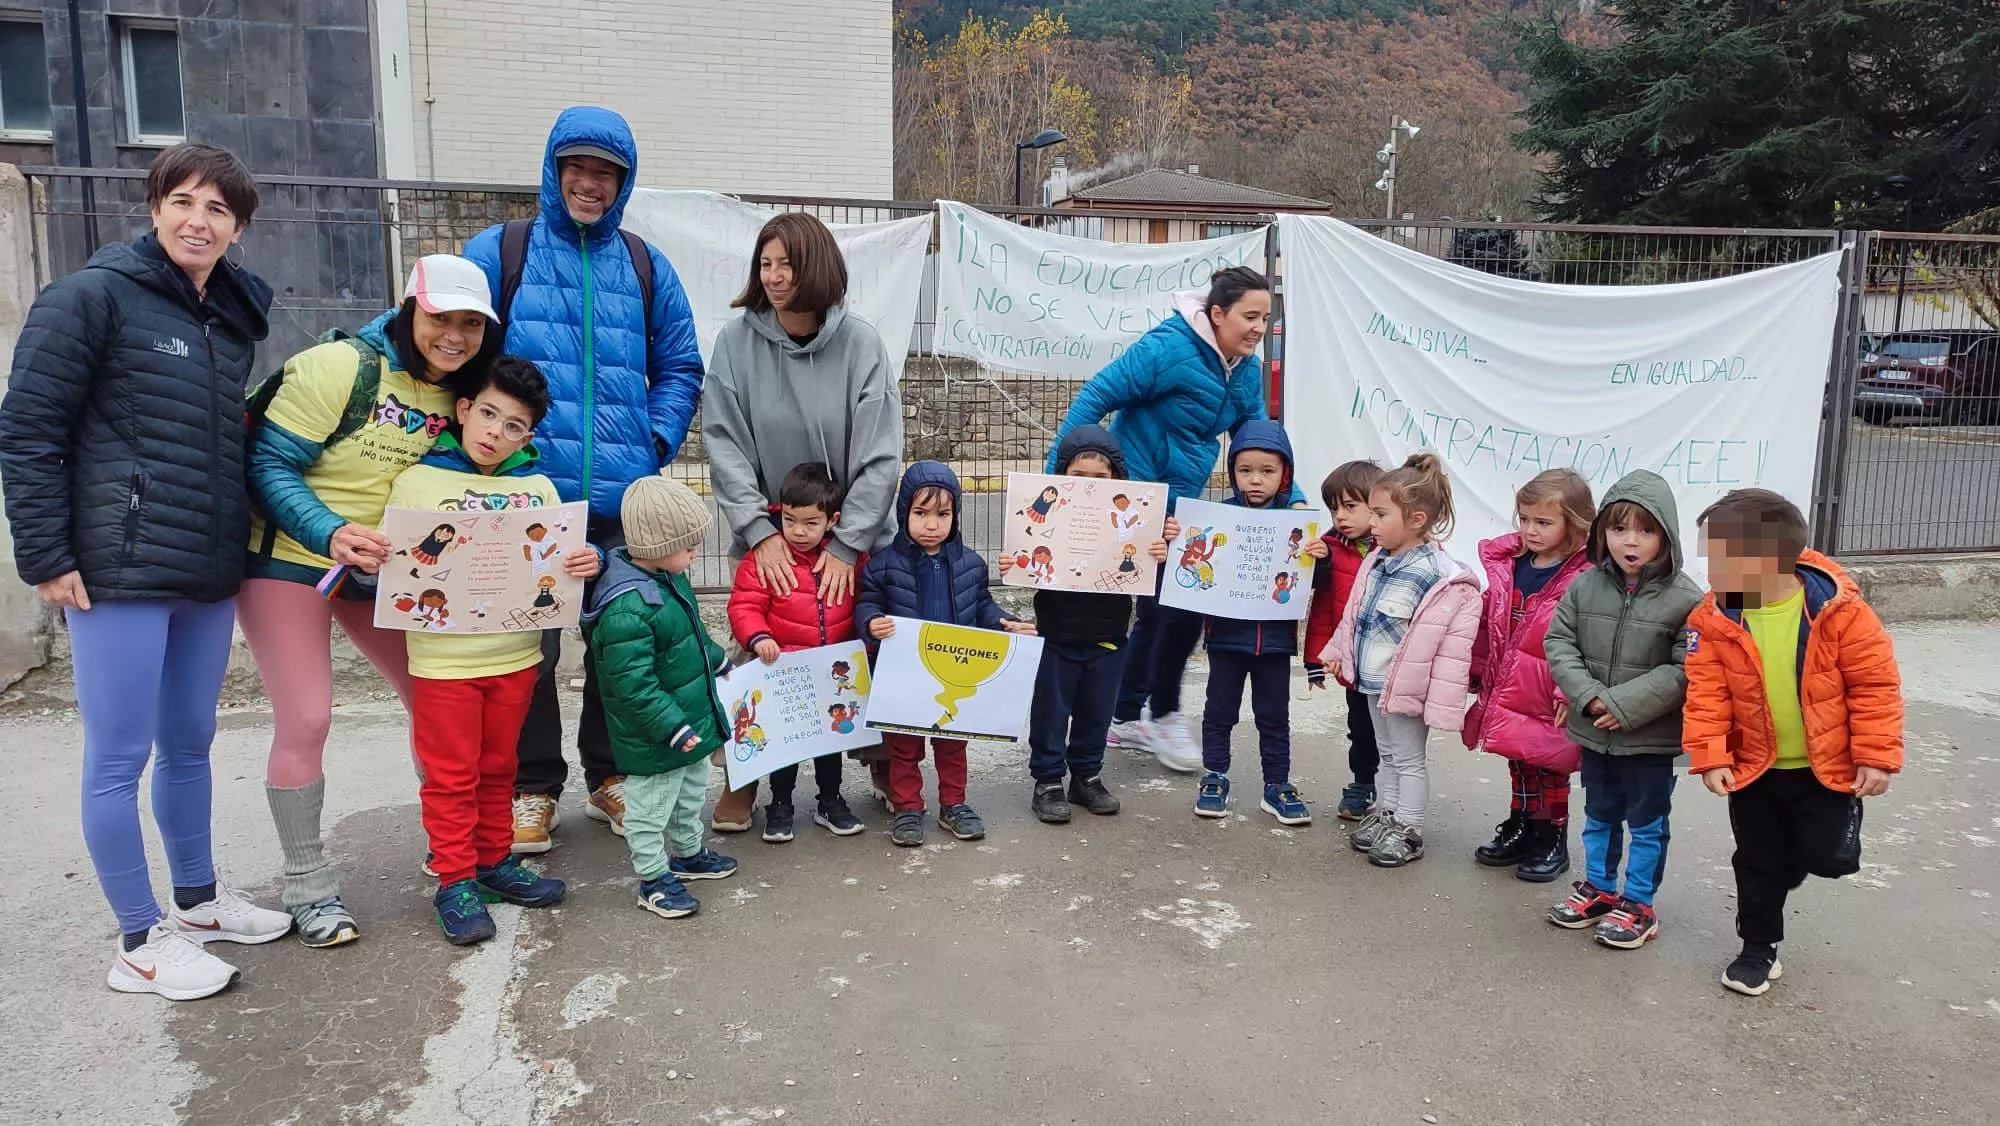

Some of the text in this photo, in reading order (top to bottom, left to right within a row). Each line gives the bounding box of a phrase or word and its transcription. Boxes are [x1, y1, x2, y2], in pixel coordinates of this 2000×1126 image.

[957, 213, 1008, 283] ¡LA
[973, 287, 1166, 333] NO SE VEN
[1611, 356, 1758, 385] EN IGUALDAD...
[379, 454, 393, 463] UN
[1235, 525, 1276, 534] QUEREMOS
[1247, 535, 1275, 544] QUE LA
[1229, 591, 1265, 600] DERECHO
[927, 642, 1000, 661] SOLUCIONES
[955, 655, 970, 665] YA
[764, 665, 810, 680] QUEREMOS
[779, 677, 797, 686] QUE
[784, 729, 823, 744] DERECHO
